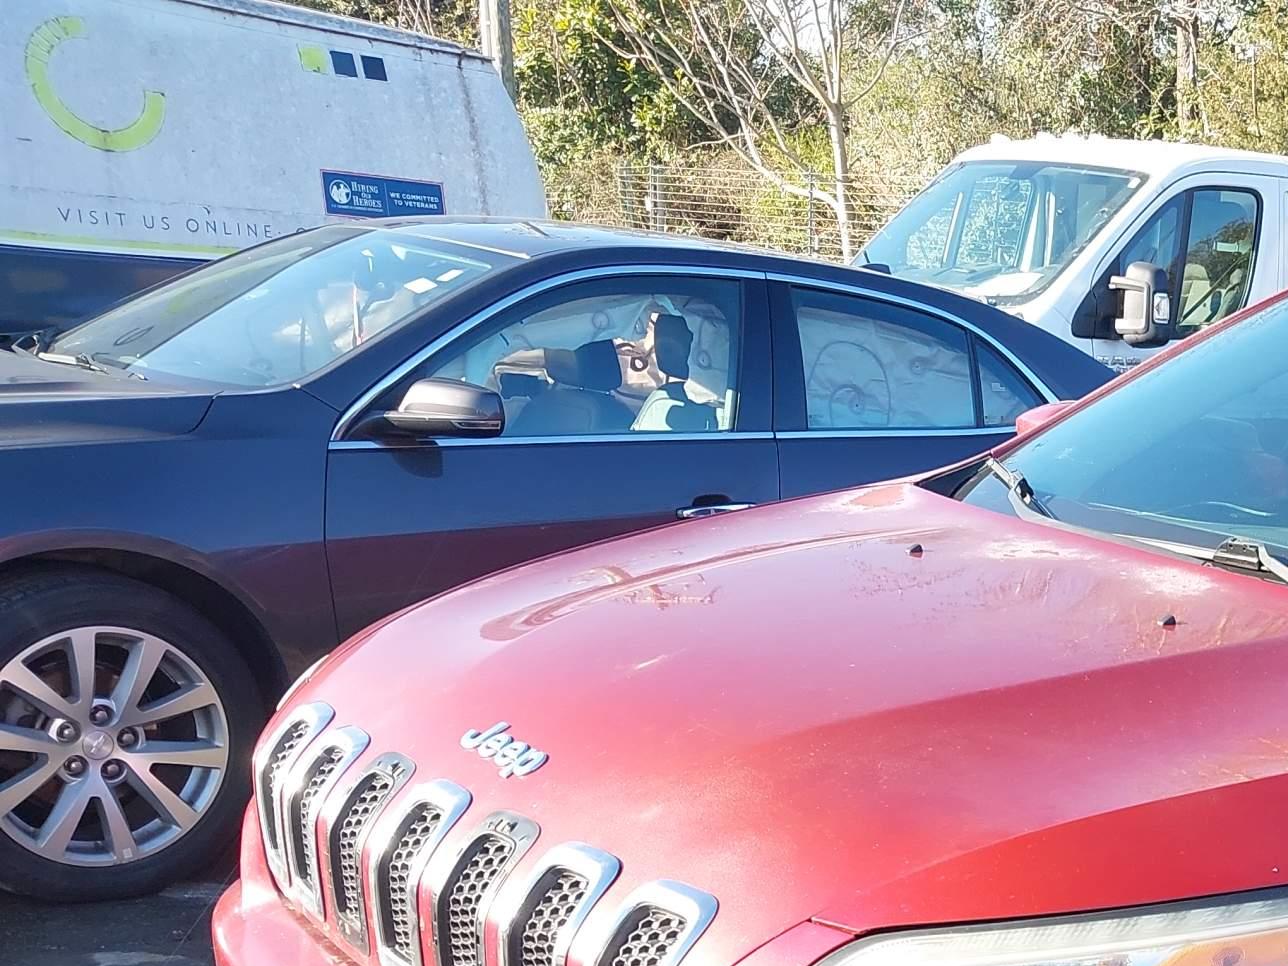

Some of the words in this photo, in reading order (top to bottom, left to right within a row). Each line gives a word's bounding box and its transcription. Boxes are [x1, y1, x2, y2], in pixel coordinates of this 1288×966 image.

[351, 181, 379, 194] HIRING
[352, 195, 382, 208] HEROES
[389, 191, 400, 199] WE
[402, 192, 440, 203] COMMITTED
[405, 200, 438, 210] VETERANS
[57, 207, 126, 227] VISIT
[143, 215, 170, 231] US
[460, 720, 549, 779] Jeep
